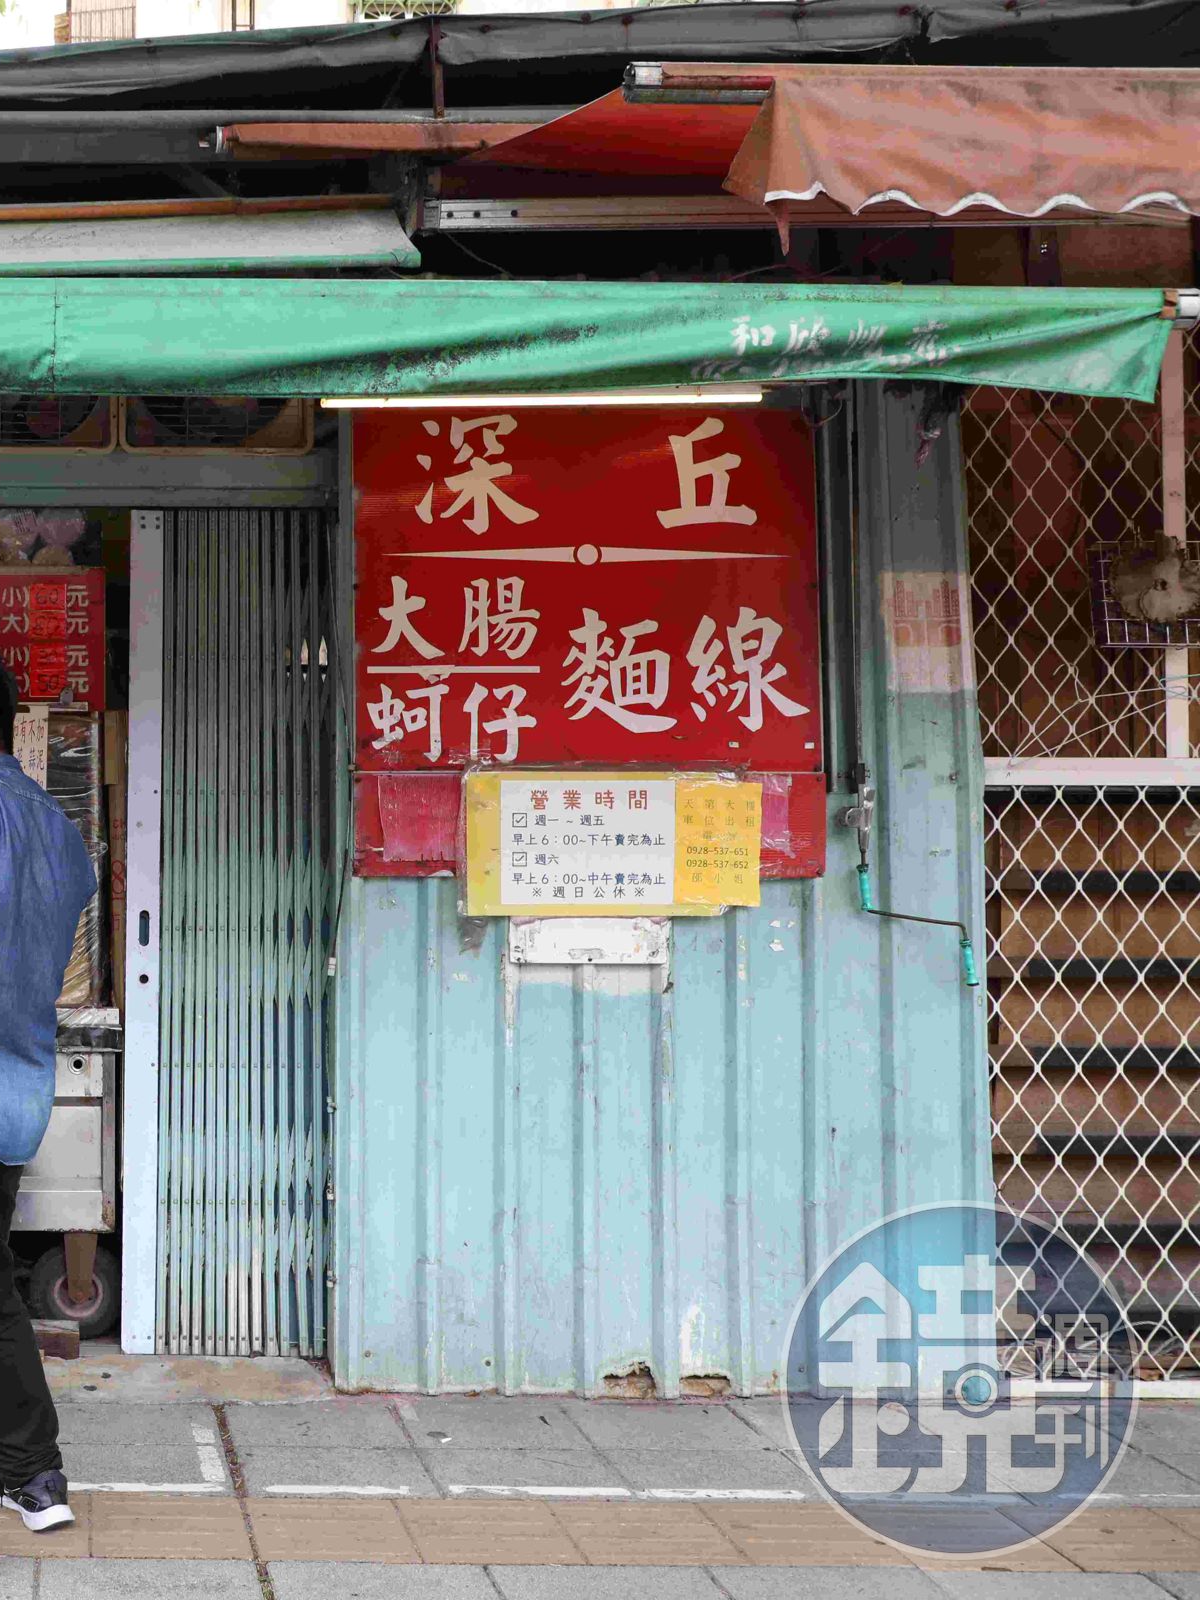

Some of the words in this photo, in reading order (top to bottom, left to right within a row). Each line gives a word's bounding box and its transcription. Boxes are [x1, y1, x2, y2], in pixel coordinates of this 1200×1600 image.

[414, 413, 758, 536] 深丘
[370, 575, 541, 661] 大腸
[560, 606, 811, 735] 麵線
[366, 681, 538, 763] 蚵仔
[530, 789, 648, 810] 營業時間
[534, 853, 560, 866] 週六
